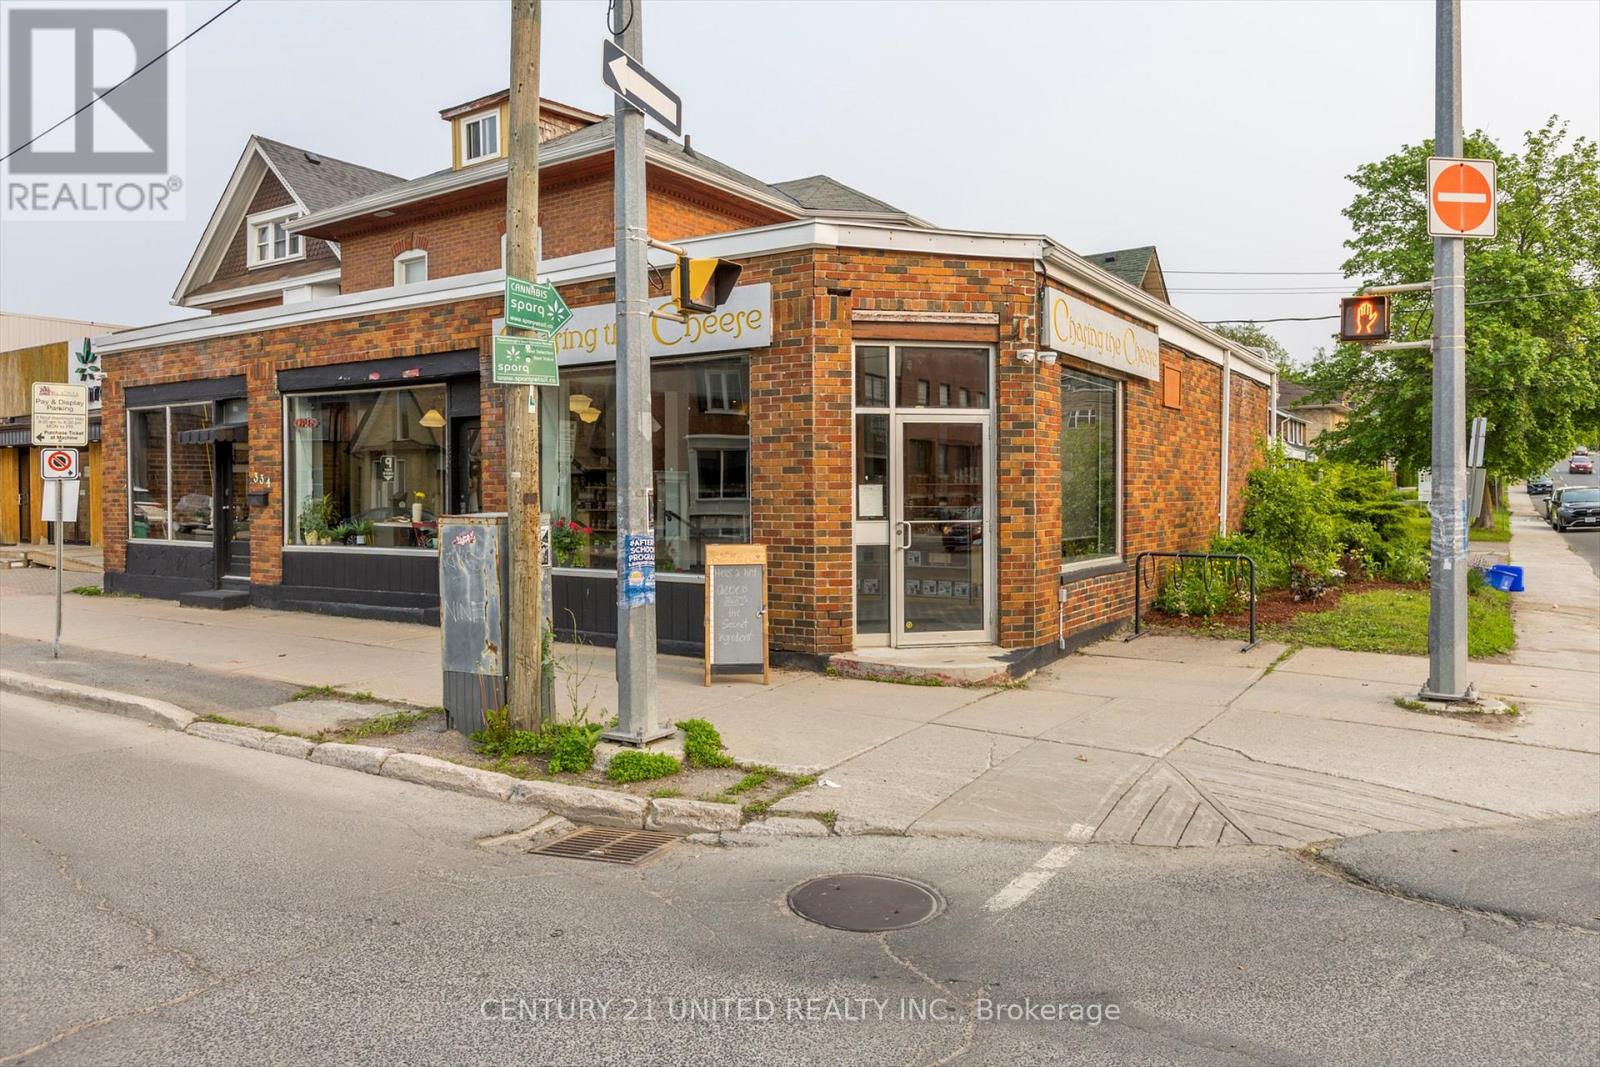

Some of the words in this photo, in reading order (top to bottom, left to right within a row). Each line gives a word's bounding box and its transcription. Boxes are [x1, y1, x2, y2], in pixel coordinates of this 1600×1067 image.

[510, 282, 548, 299] CANNABIS
[510, 299, 545, 318] sparq
[1106, 331, 1121, 359] the
[498, 363, 530, 374] sparq
[630, 546, 655, 554] SCHOO
